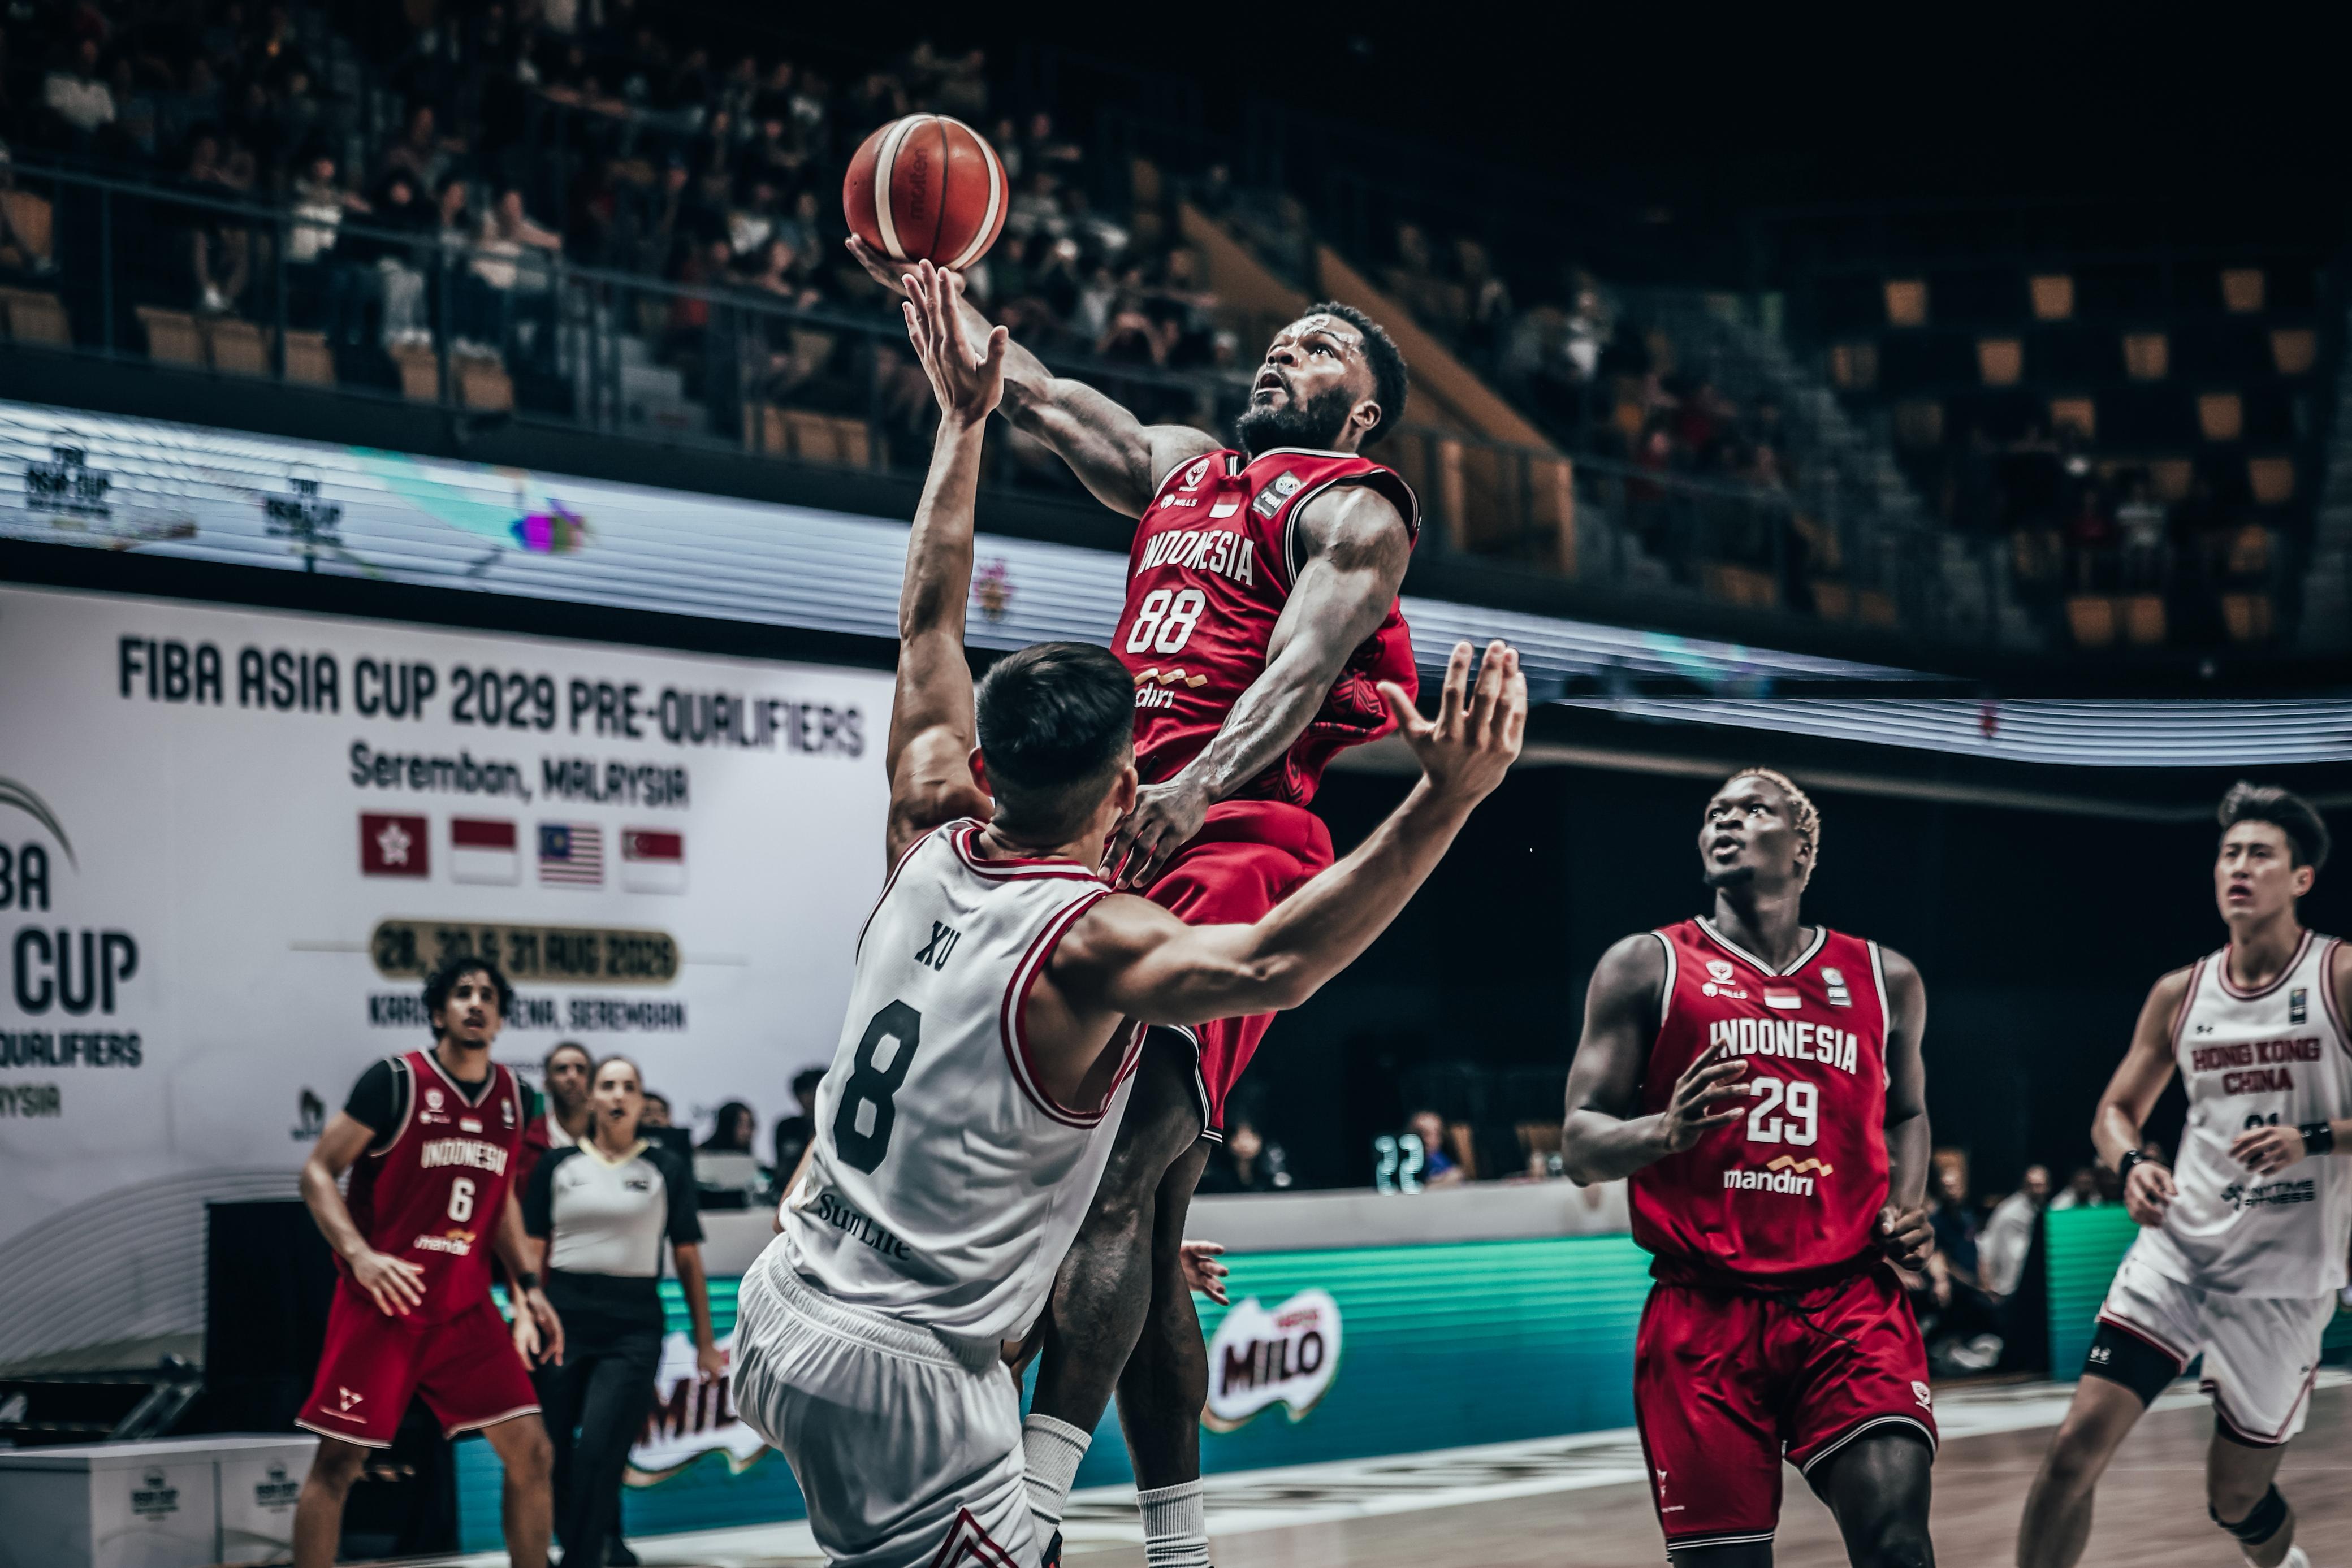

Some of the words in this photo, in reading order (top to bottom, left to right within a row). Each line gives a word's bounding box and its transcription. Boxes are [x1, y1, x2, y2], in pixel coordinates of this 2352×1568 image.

[909, 148, 929, 220] molten
[1136, 530, 1254, 586] INDONESIA
[1126, 589, 1205, 654] 88
[119, 634, 222, 705] FIBA
[238, 646, 340, 715] ASIA
[354, 657, 436, 721] CUP
[451, 665, 557, 730] 2029
[569, 678, 864, 758] PRE-QUALIFIERS
[1134, 683, 1175, 709] diri
[350, 738, 533, 804] Seremban,
[542, 757, 690, 808] MALAYSIA
[12, 926, 139, 1016] CUP
[914, 920, 961, 972] XU
[1709, 1018, 1858, 1075] INDONESIA
[2191, 1043, 2252, 1072] HONG
[2255, 1038, 2321, 1064] KONG
[833, 999, 922, 1176] 8
[1746, 1076, 1819, 1146] 29
[2221, 1067, 2294, 1096] CHINA
[1374, 1134, 1425, 1196] 22
[1723, 1168, 1814, 1197] mandiri
[449, 1176, 476, 1223] 6
[1220, 1331, 1324, 1398] MILO
[637, 1375, 742, 1450] MIL
